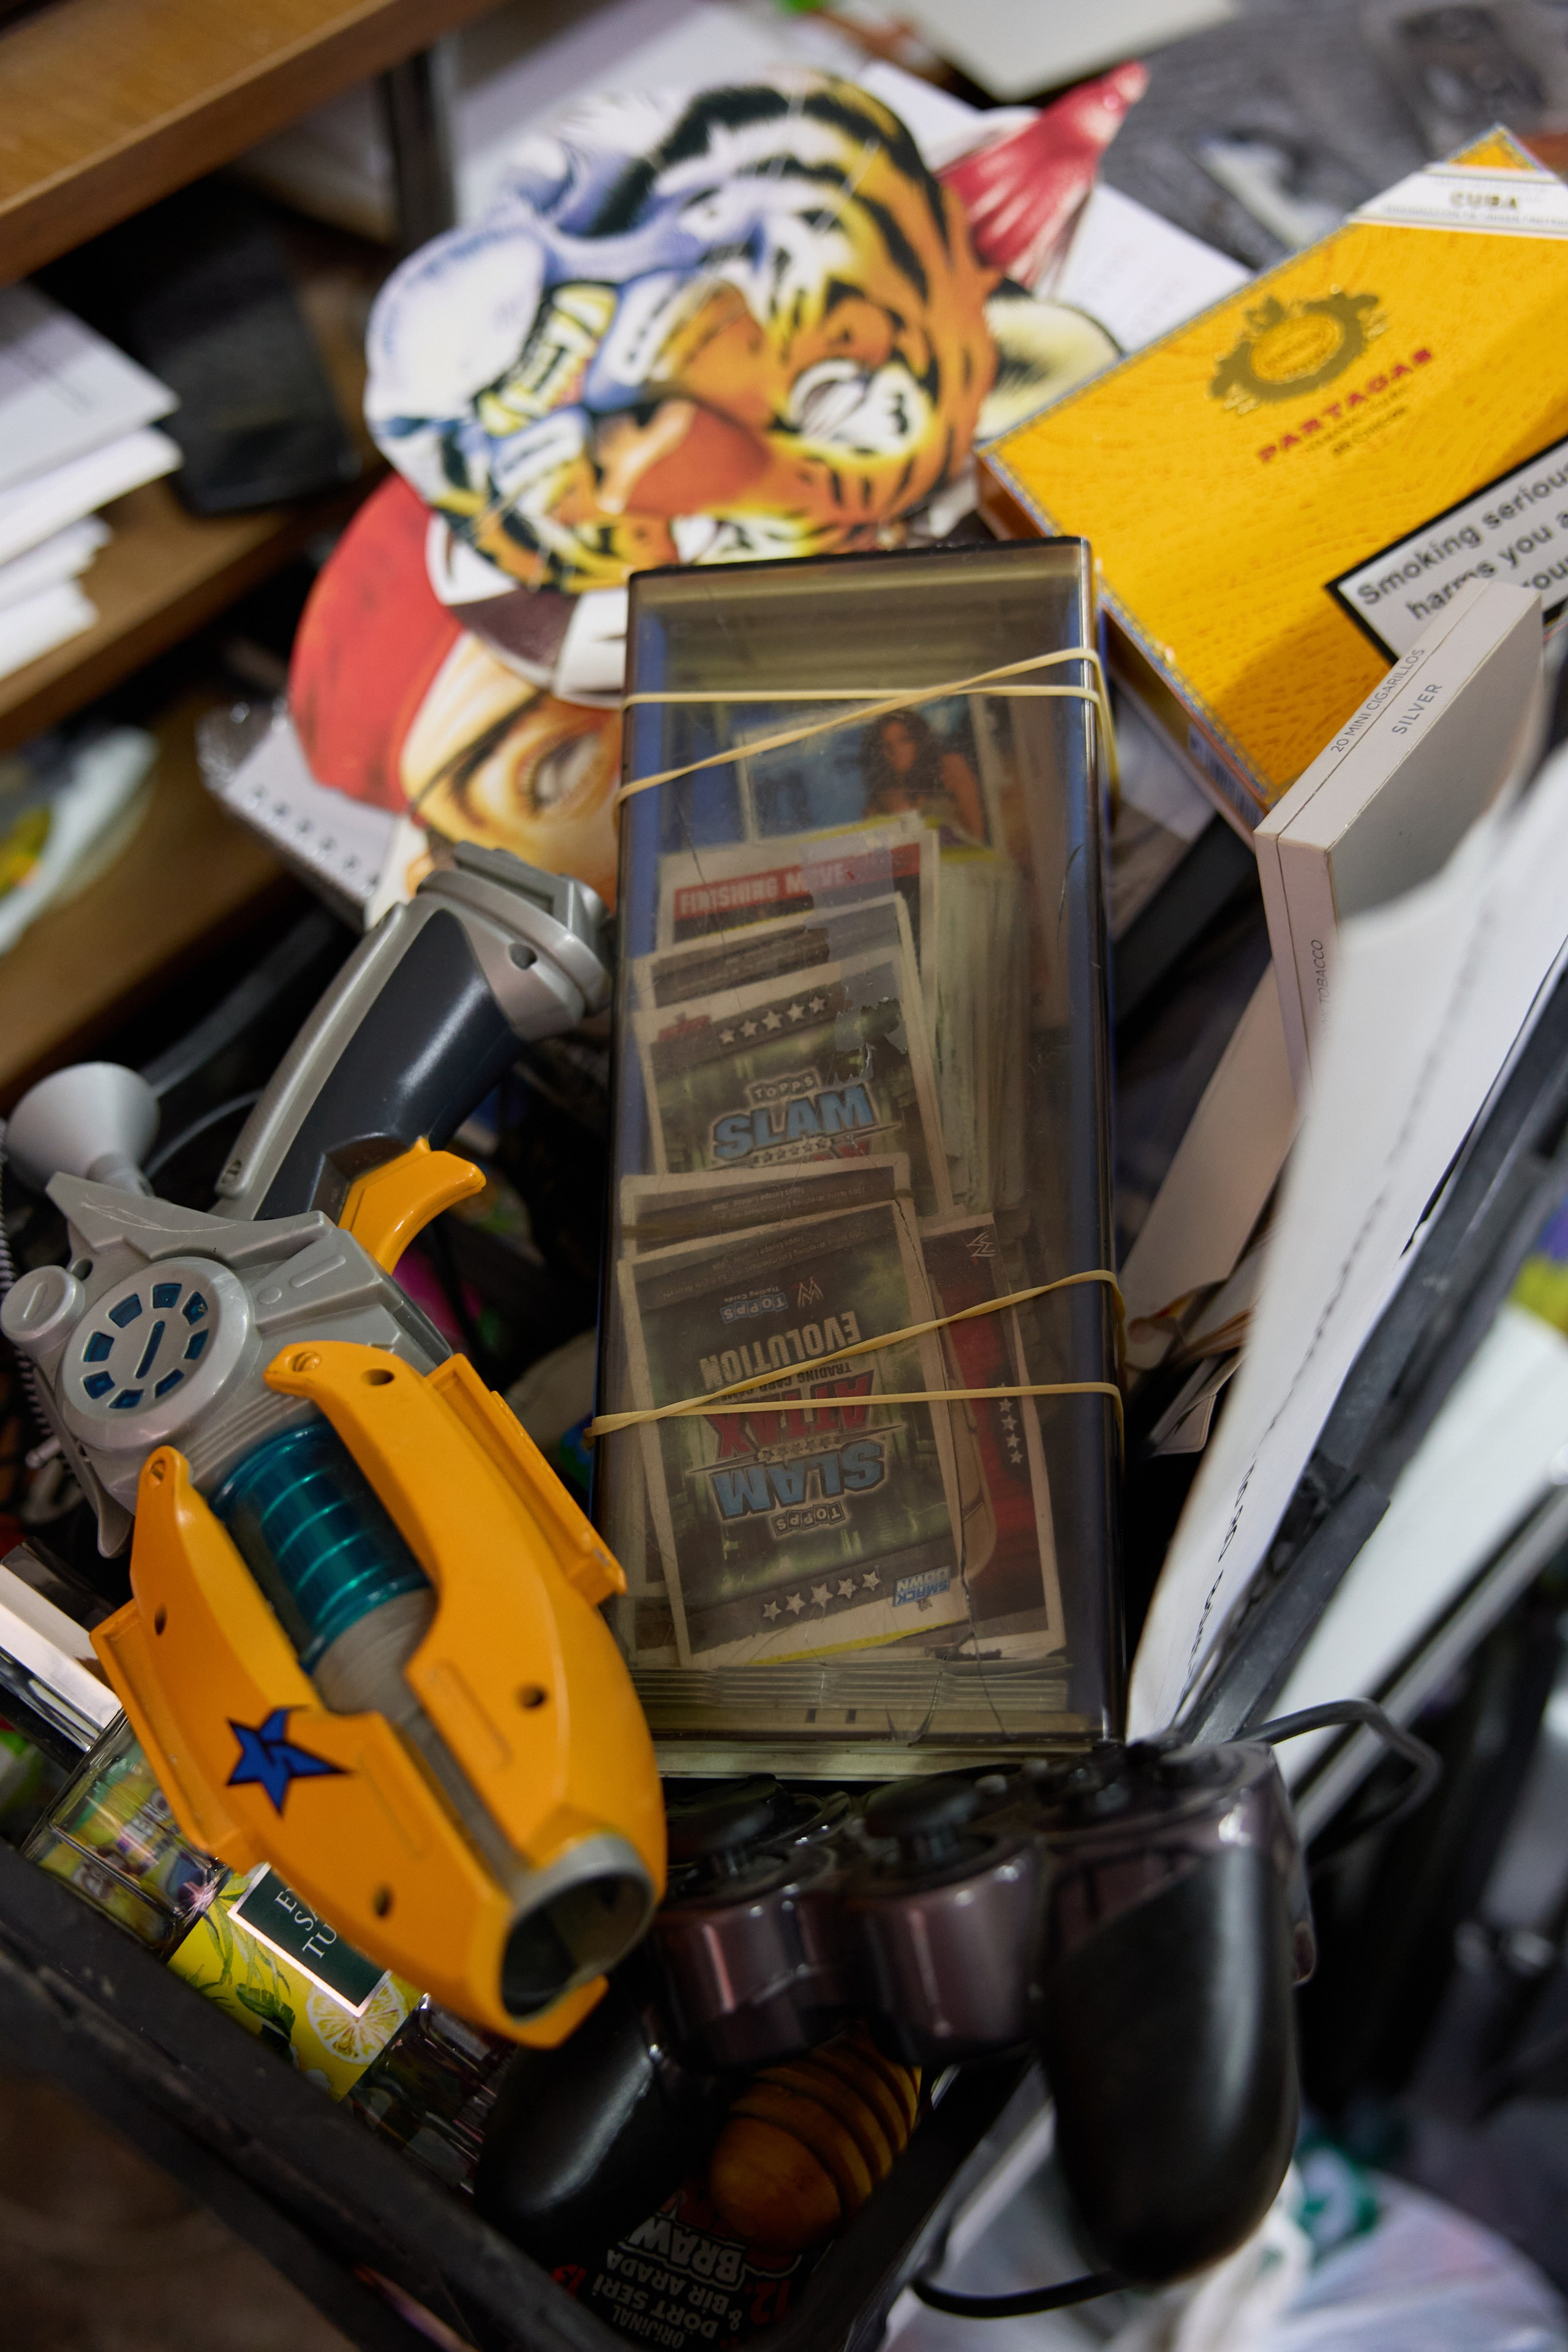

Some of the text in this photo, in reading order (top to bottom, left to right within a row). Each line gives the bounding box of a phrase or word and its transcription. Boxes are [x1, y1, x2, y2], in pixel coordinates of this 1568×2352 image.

[1450, 190, 1517, 209] CUBA
[1257, 348, 1432, 463] PARTAGAS
[1357, 524, 1482, 605] Smoking
[1482, 462, 1568, 530] seriou
[1497, 524, 1553, 568] you
[1330, 648, 1426, 753] 20 MINI CIGARILLOS
[1392, 684, 1442, 735] SILVER
[680, 862, 847, 916] FINISHING MVE
[1311, 939, 1331, 1006] TOBACCO
[754, 1074, 815, 1099] TOPPS
[713, 1085, 875, 1161] SLAM
[721, 1295, 787, 1322] TOPPS
[723, 1284, 781, 1303] Trading Cards
[699, 1310, 862, 1391] EVOLUTION
[797, 1362, 852, 1384] TRADING
[703, 1377, 872, 1458] ATTAX
[711, 1439, 884, 1519] SLAM
[774, 1504, 843, 1533] TOPPS
[894, 1580, 949, 1605] SMACK
[896, 1567, 949, 1591] DOWN
[606, 2248, 687, 2297] ARADA
[650, 2299, 718, 2339] DÖRT
